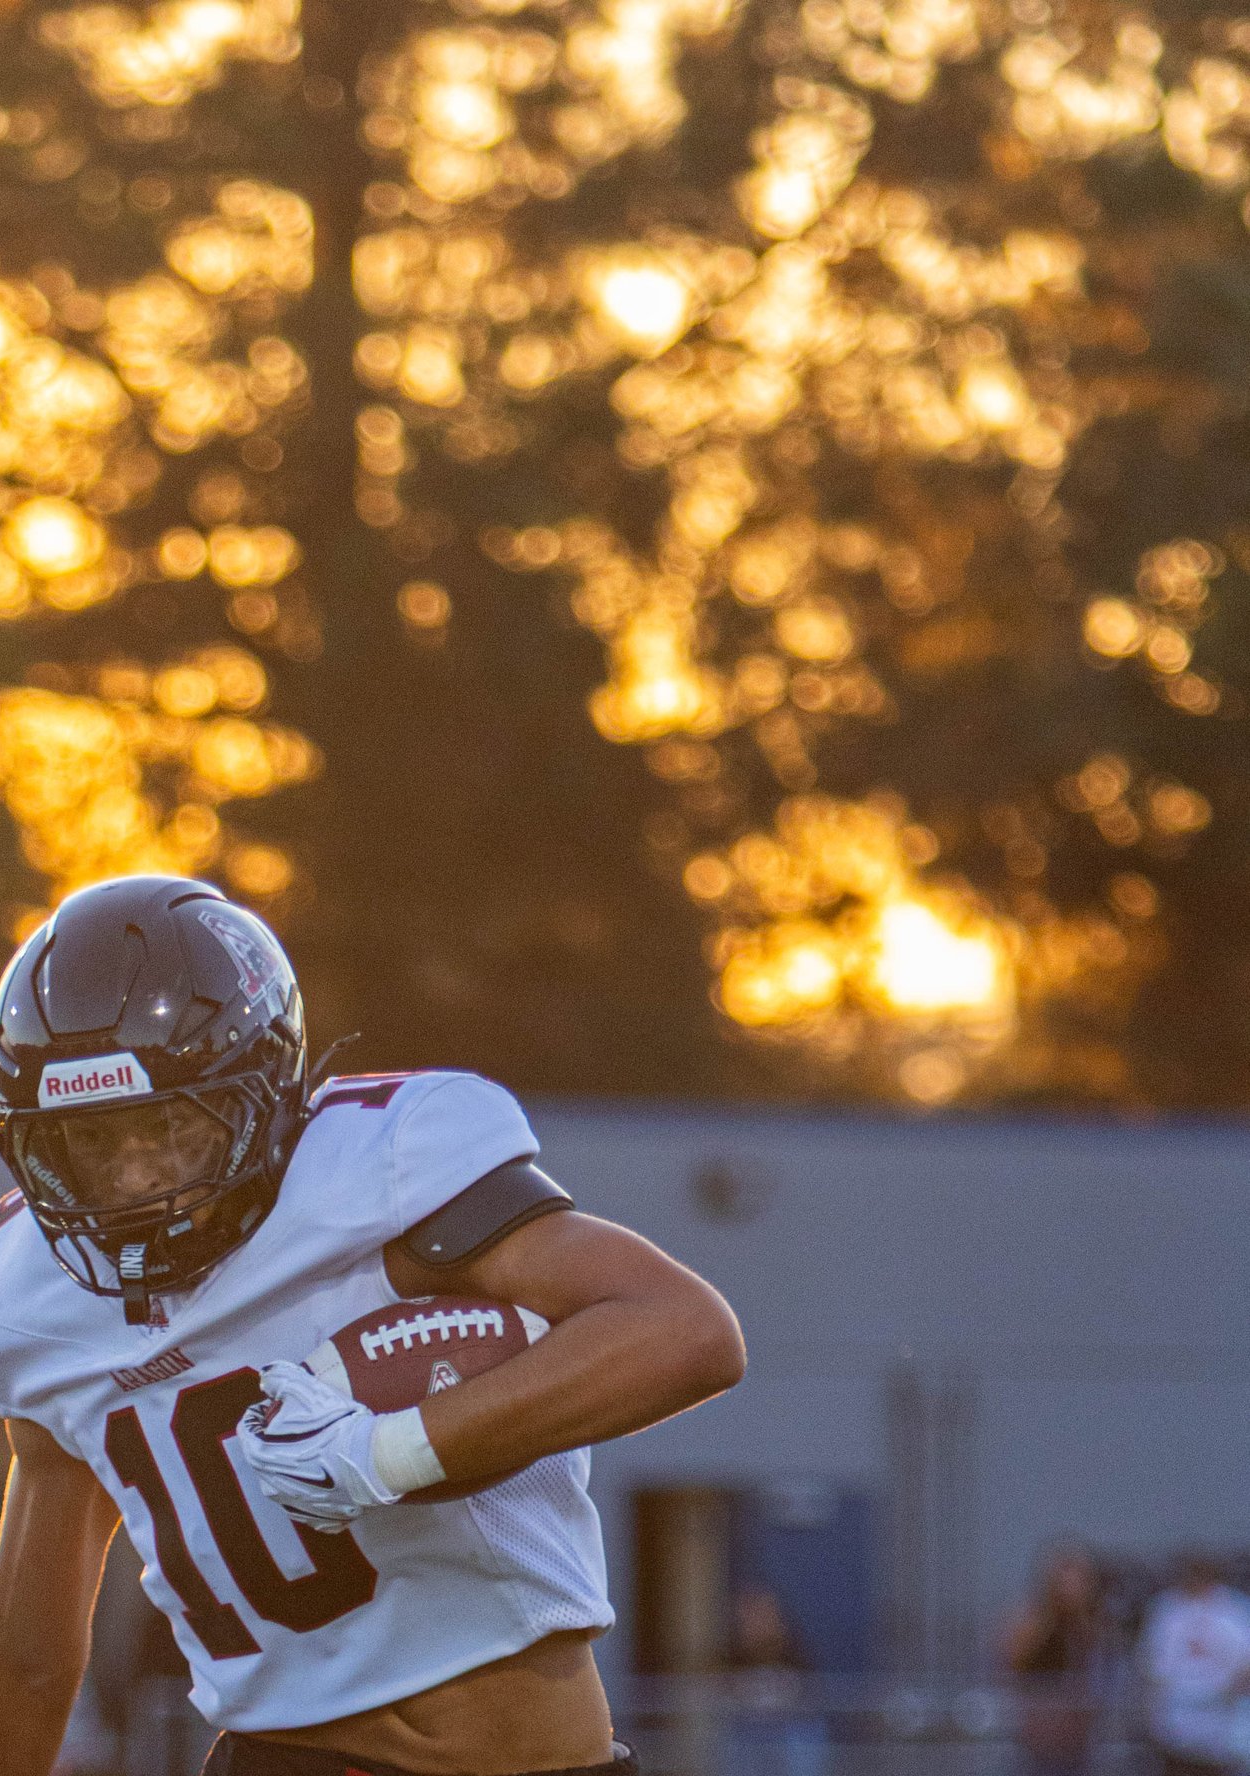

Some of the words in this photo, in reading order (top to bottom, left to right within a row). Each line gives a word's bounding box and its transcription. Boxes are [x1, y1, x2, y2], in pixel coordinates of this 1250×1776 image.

[46, 1065, 133, 1097] Riddell
[110, 1347, 196, 1392] ARAGON
[104, 1366, 379, 1661] 10
